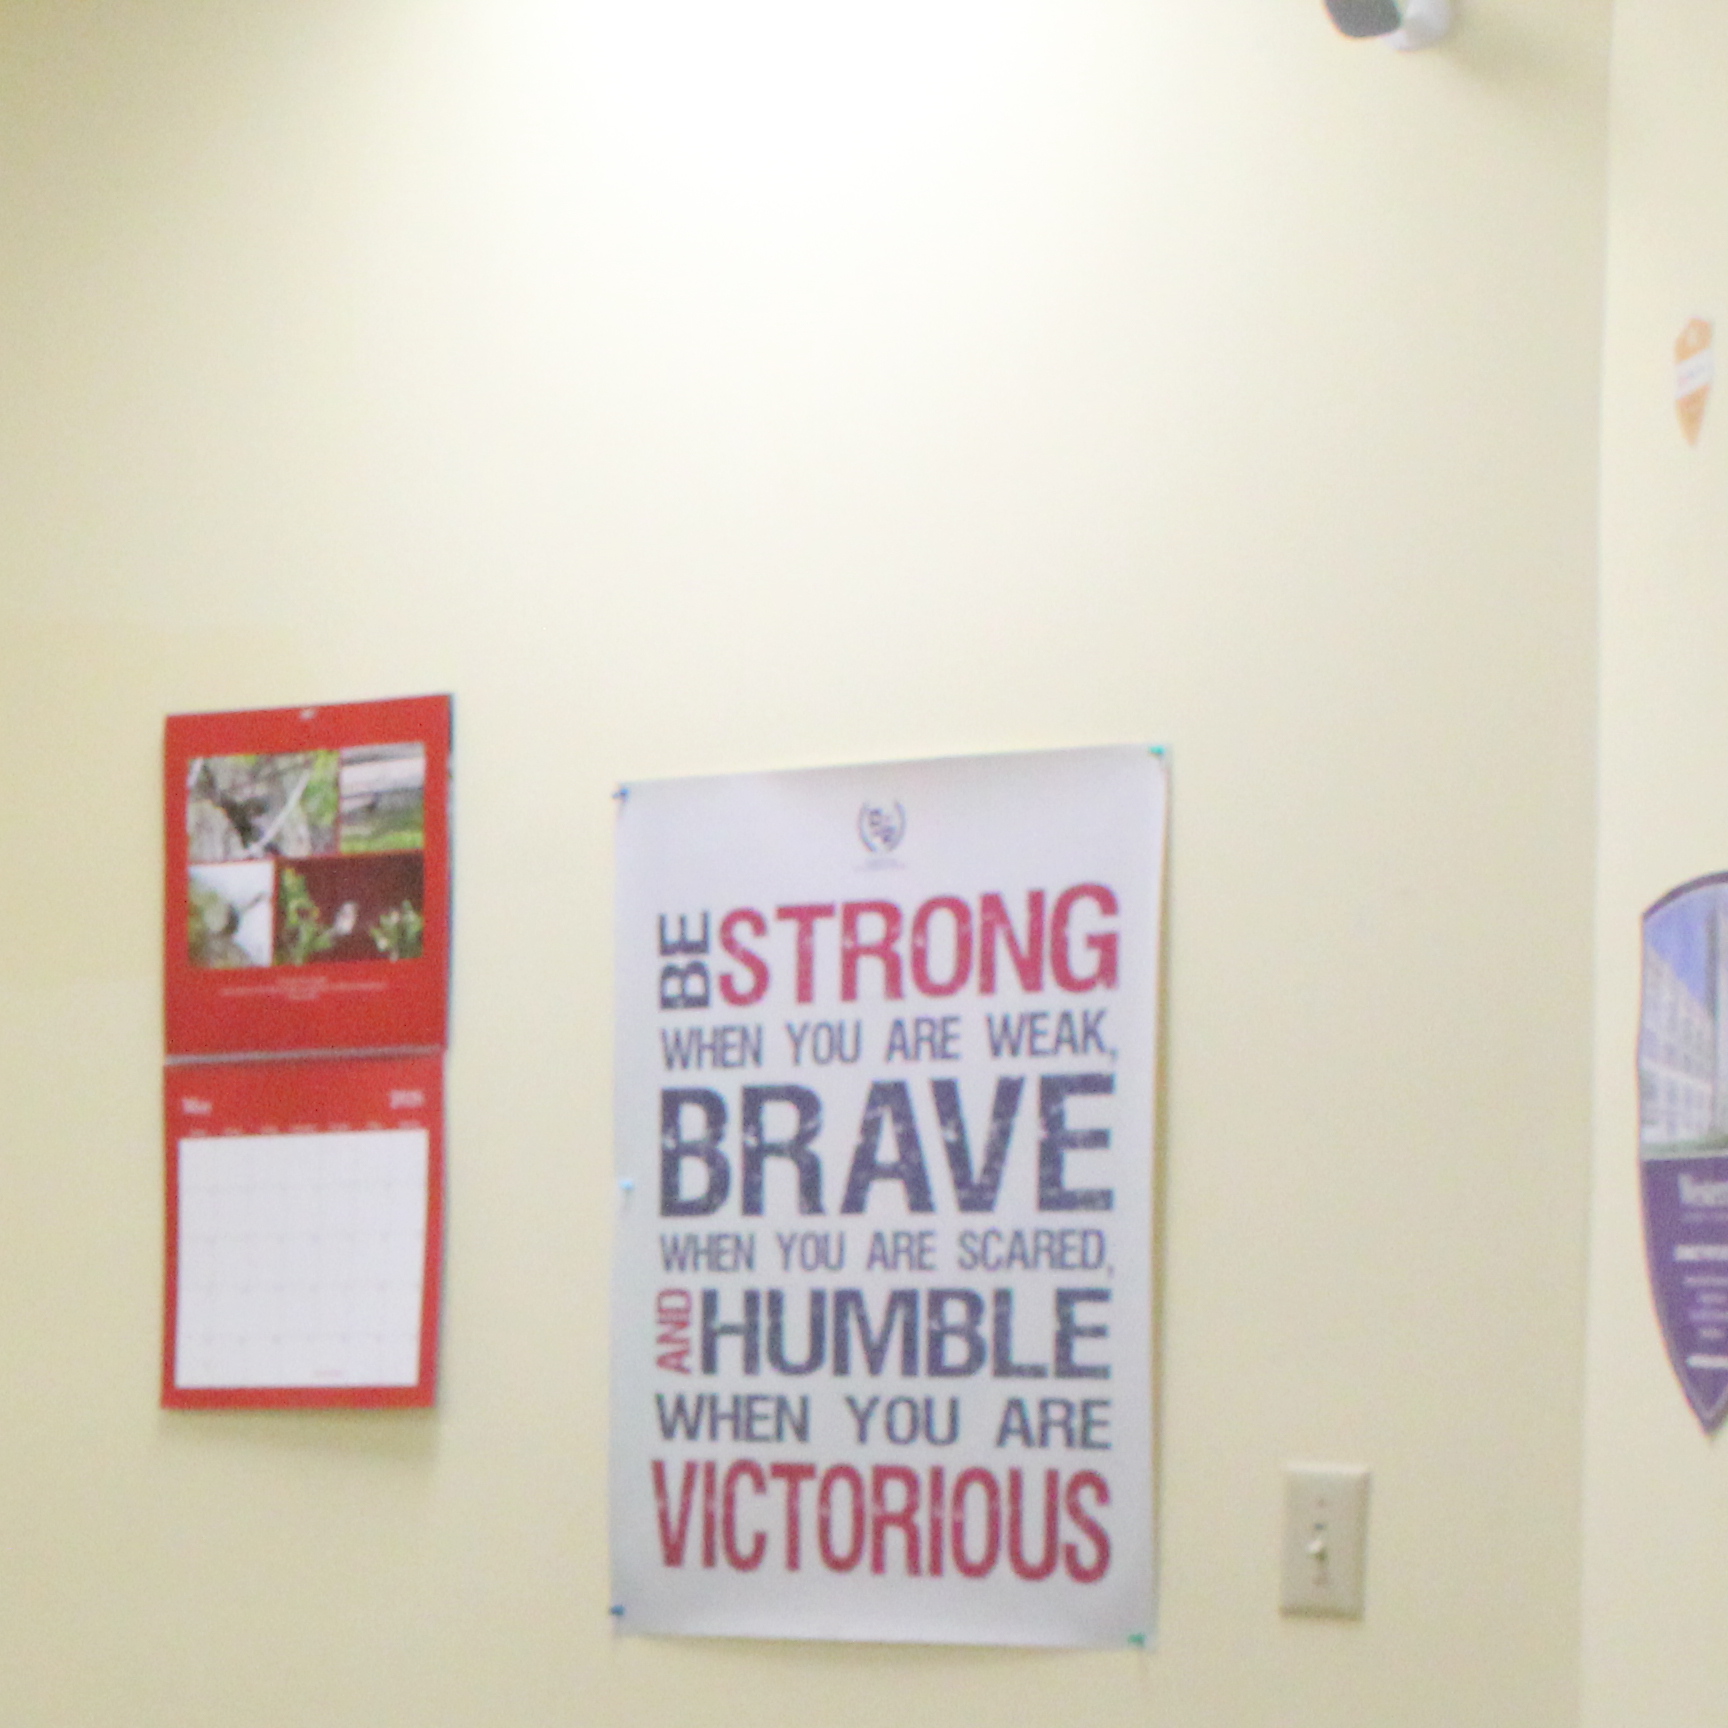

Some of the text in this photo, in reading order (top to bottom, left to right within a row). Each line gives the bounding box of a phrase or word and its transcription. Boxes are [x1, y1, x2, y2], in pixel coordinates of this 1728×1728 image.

[657, 881, 1120, 1010] BE STRONG
[661, 1008, 1118, 1072] WHEN YOU ARE WEAK,
[658, 1072, 1116, 1217] BRAVE
[660, 1227, 1115, 1277] WHEN YOU ARE SCARED,
[656, 1287, 1114, 1380] AND HUMBLE
[654, 1392, 1113, 1450] WHEN YOU ARE
[650, 1459, 1113, 1584] VICTORIOUS
